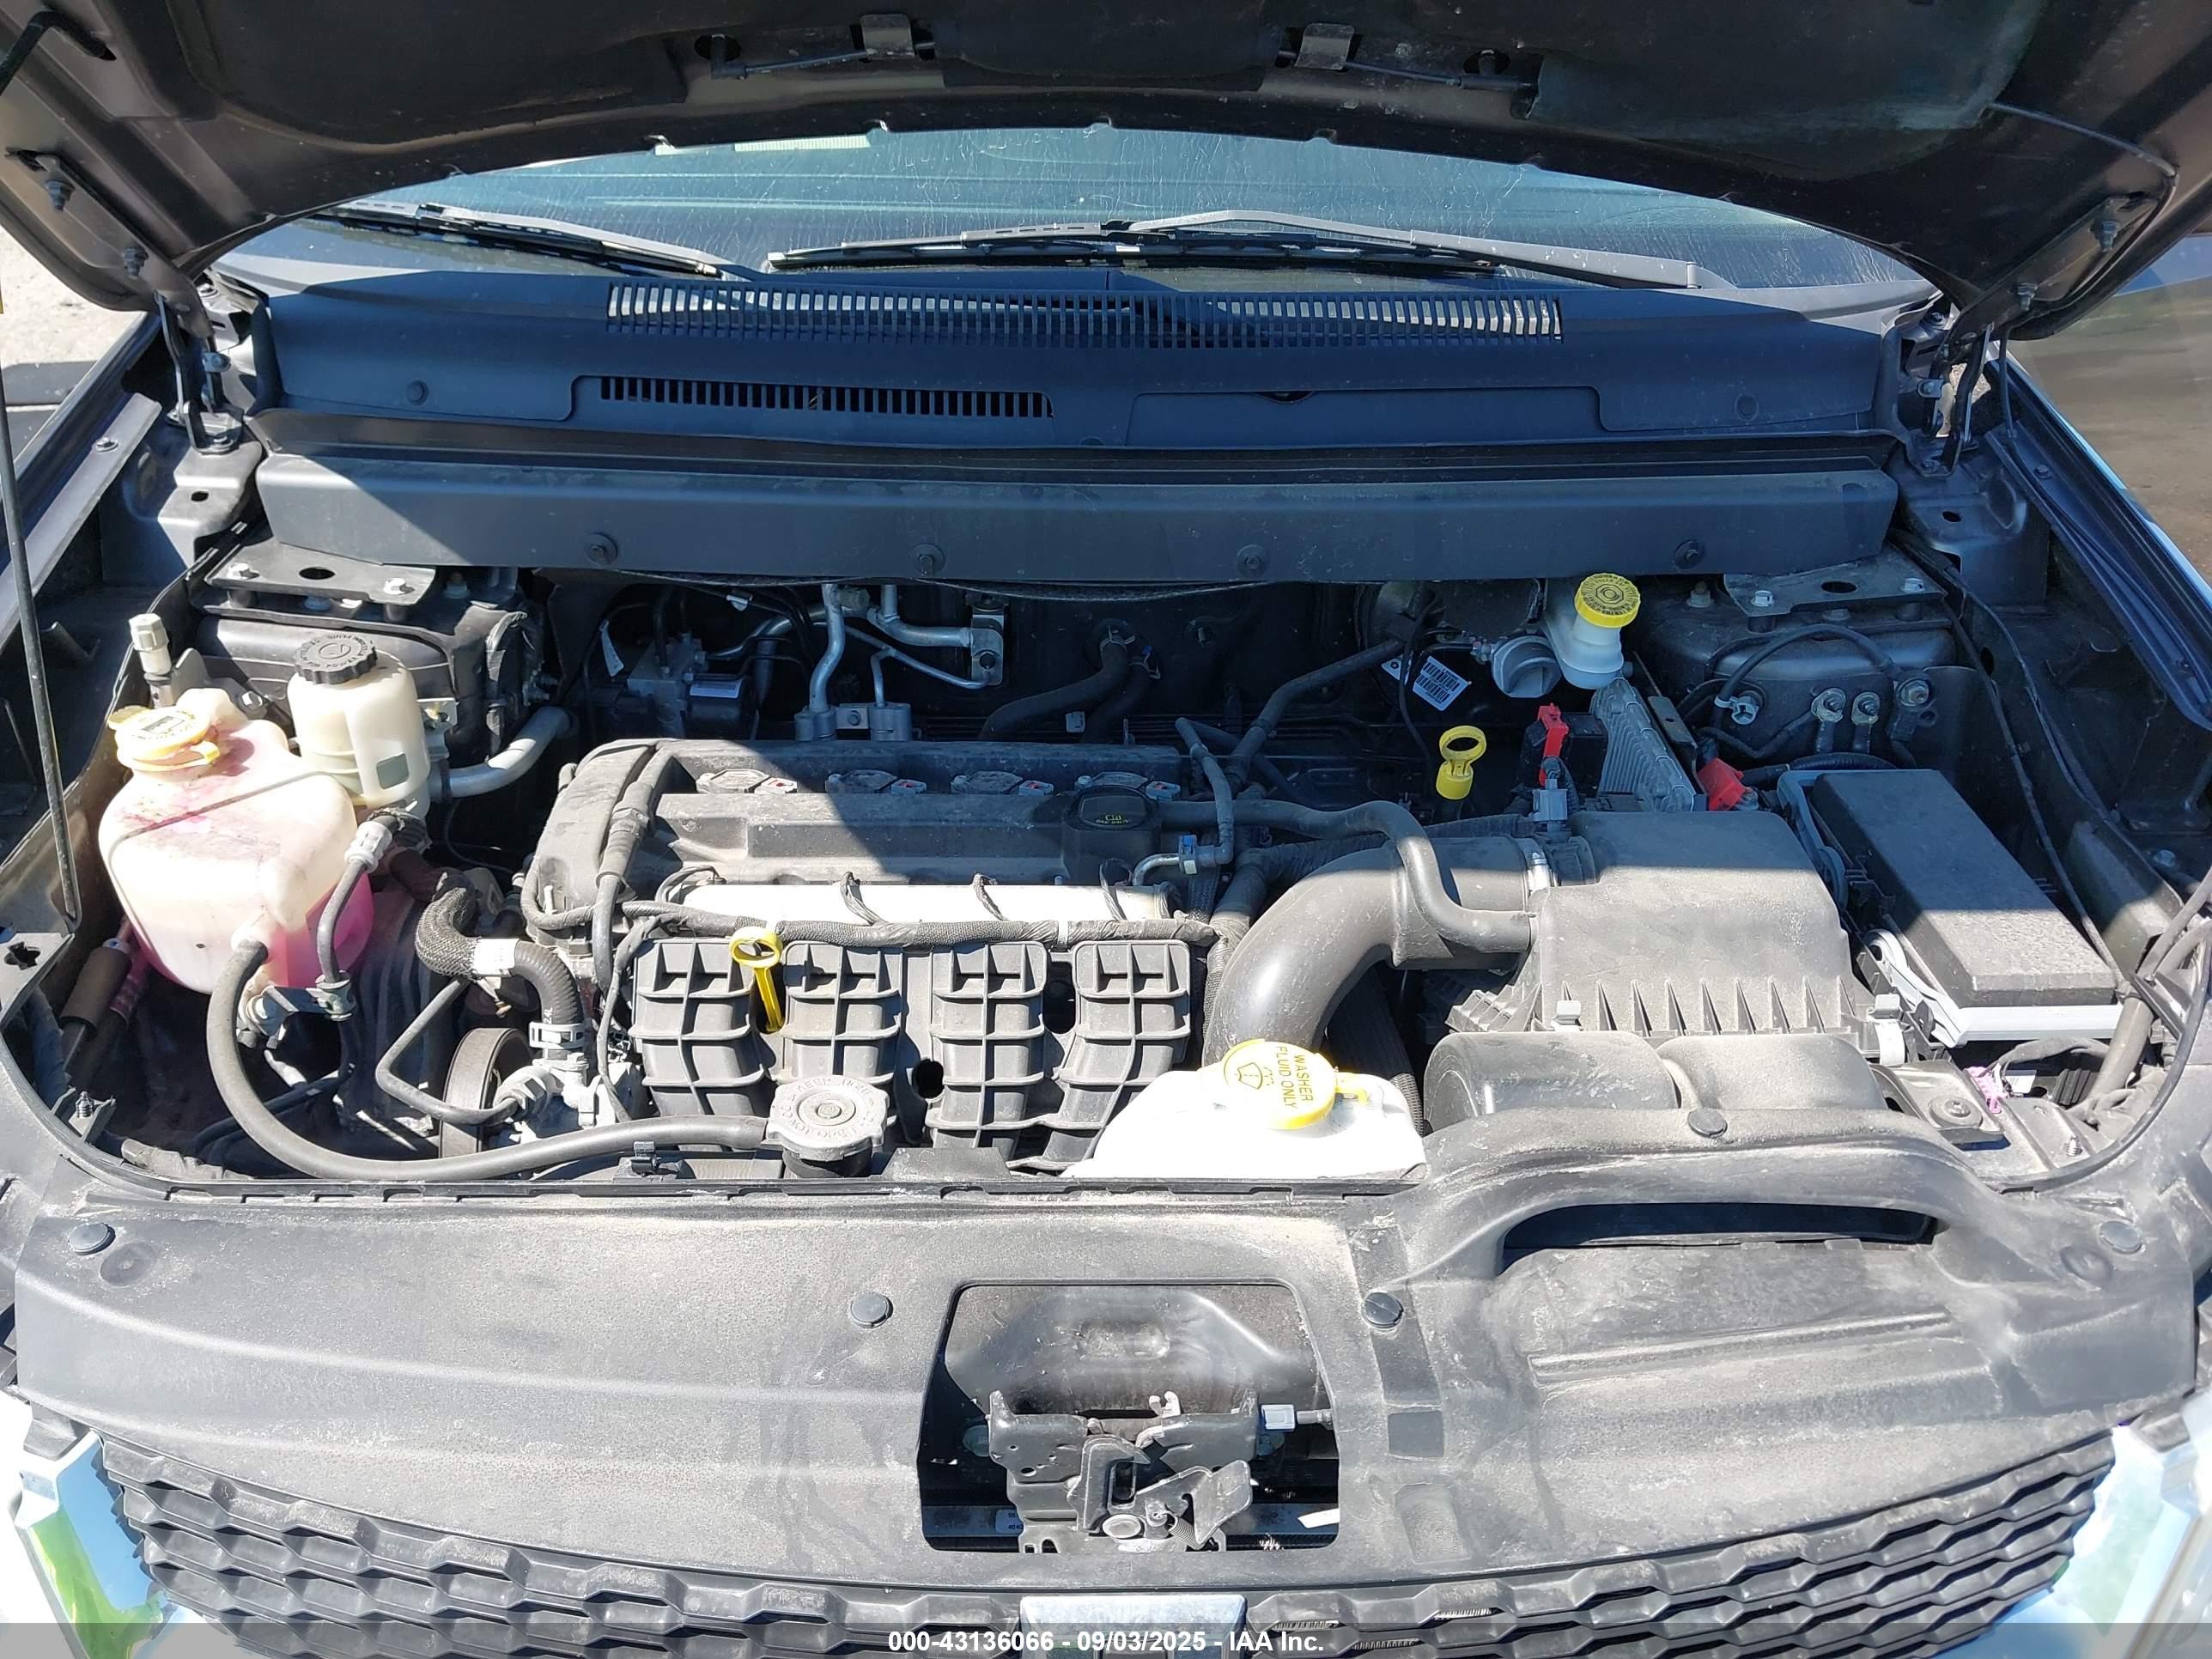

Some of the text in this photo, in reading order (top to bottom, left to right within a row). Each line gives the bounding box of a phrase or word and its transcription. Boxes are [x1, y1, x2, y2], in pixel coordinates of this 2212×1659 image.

[1276, 1046, 1297, 1109] FLUID ONLY
[1294, 1054, 1314, 1101] WASHER
